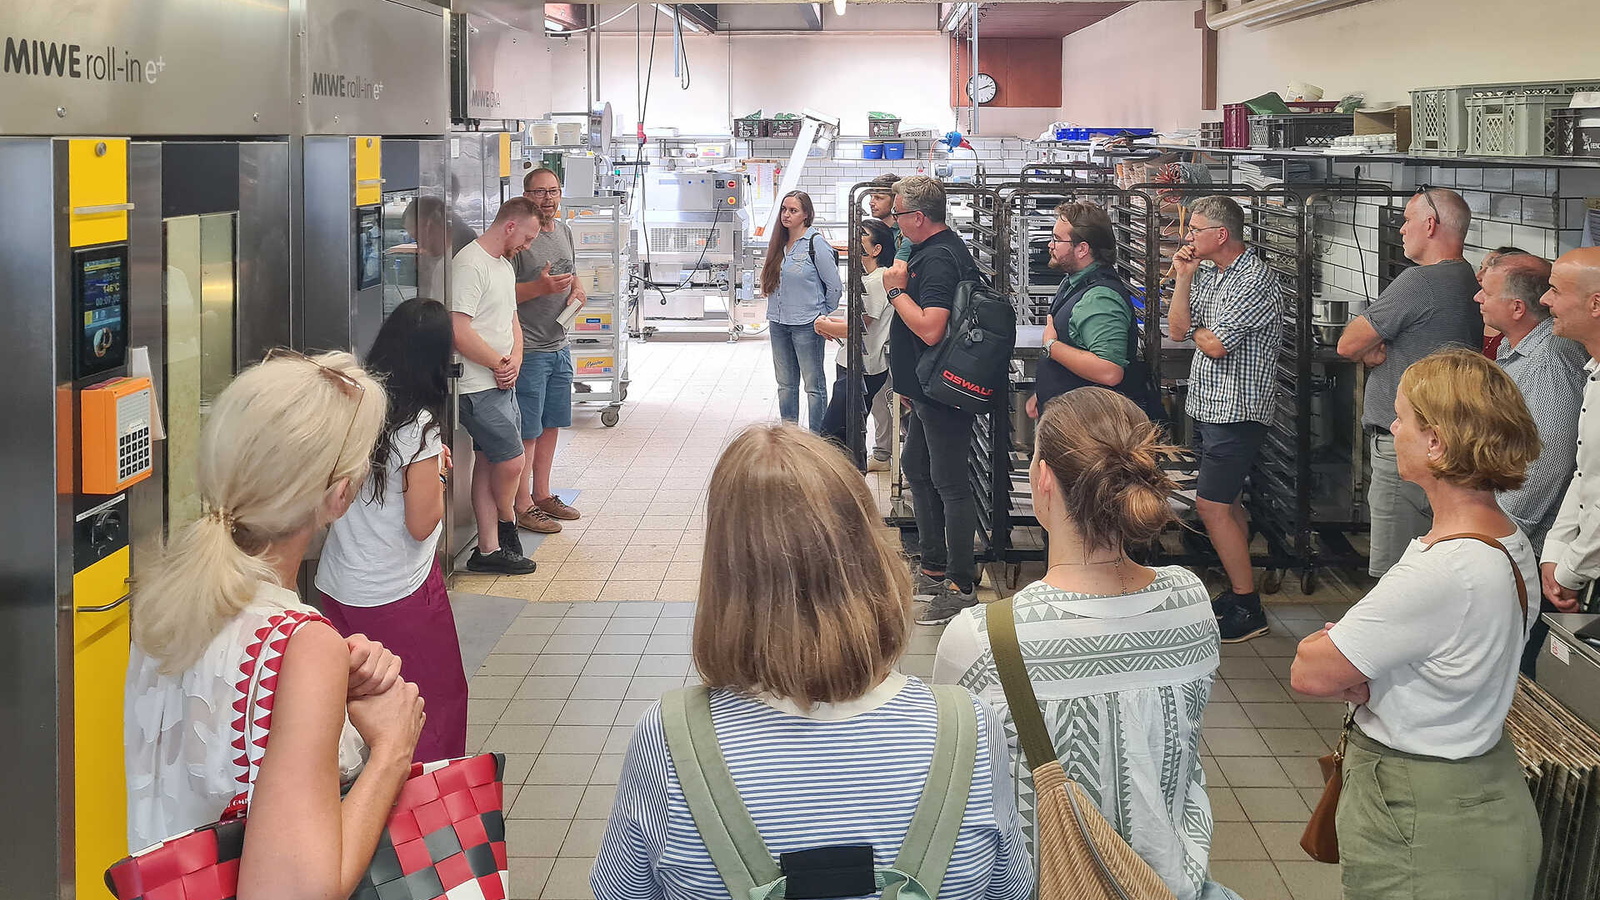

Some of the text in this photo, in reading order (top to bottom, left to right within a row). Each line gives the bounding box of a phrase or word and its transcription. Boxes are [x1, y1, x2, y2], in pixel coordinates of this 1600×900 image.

[4, 36, 81, 79] MIWE
[86, 46, 141, 83] roll-in
[312, 72, 346, 97] MIWE
[347, 75, 373, 99] roll-in
[471, 89, 489, 108] MIWE
